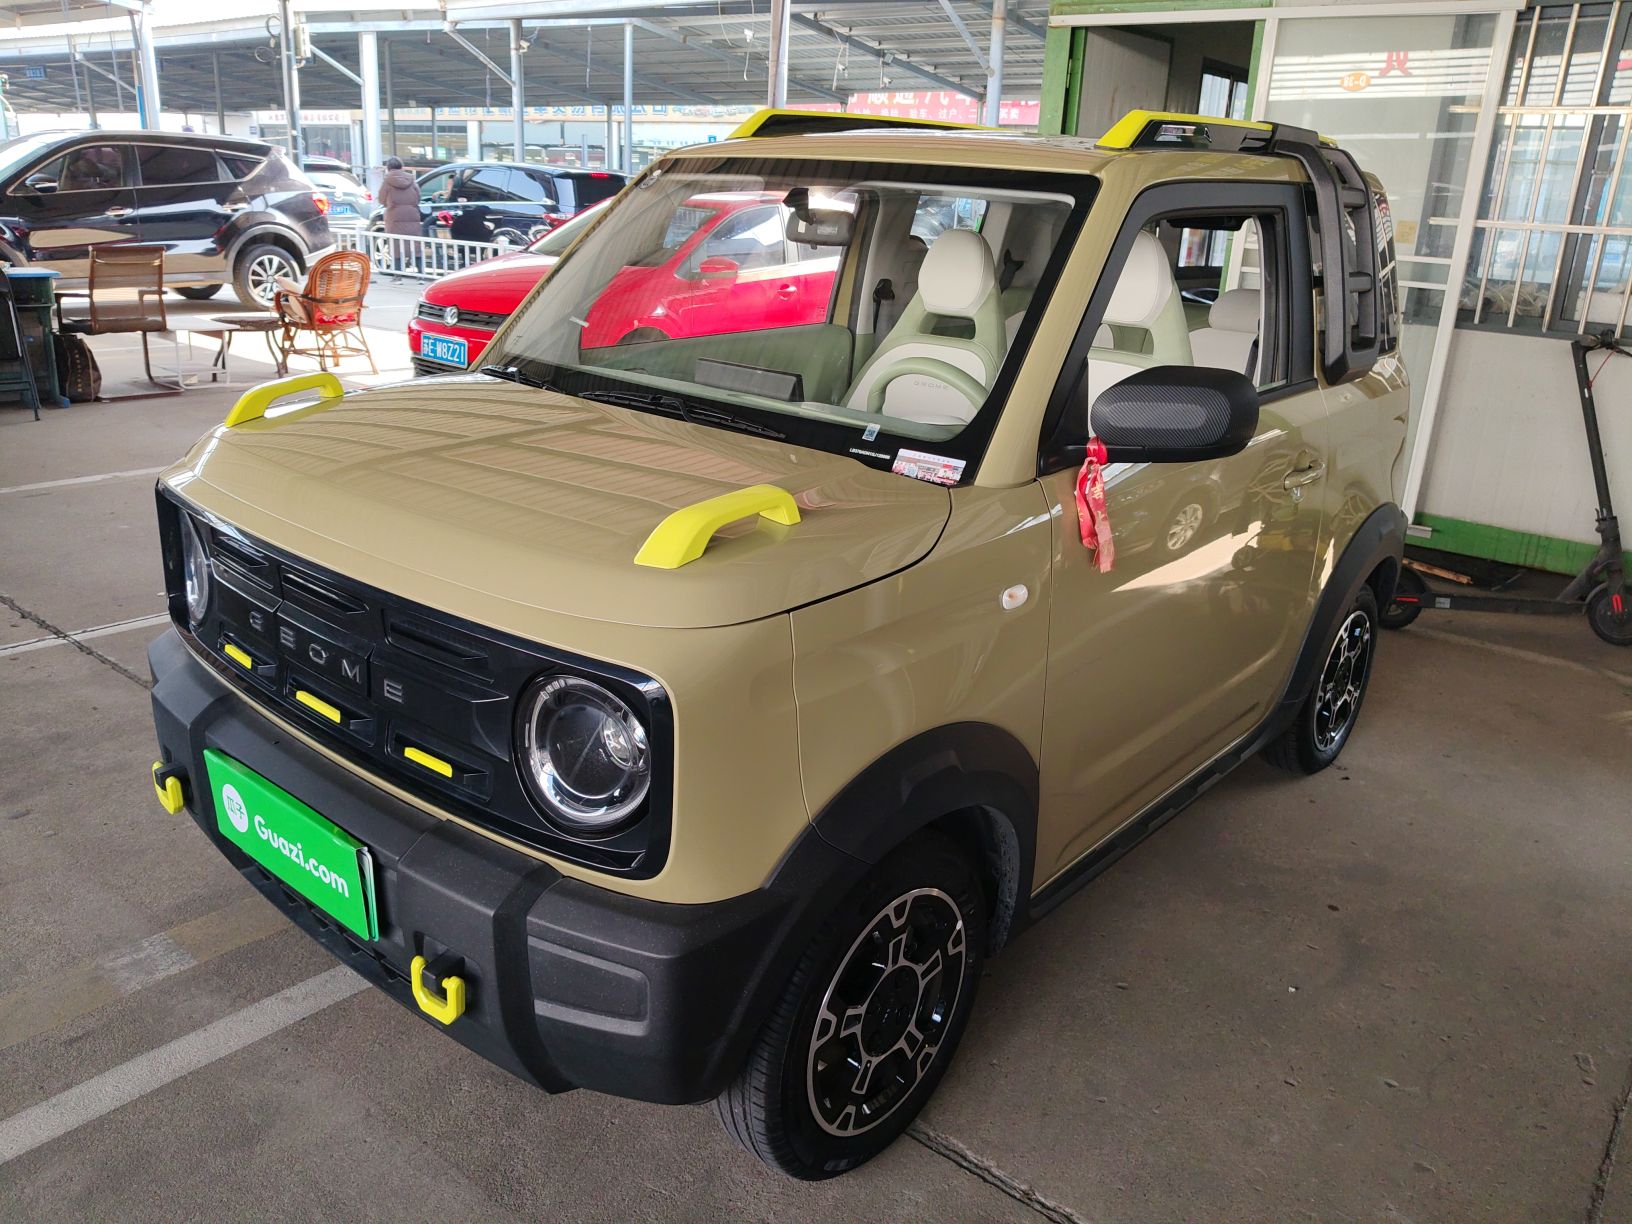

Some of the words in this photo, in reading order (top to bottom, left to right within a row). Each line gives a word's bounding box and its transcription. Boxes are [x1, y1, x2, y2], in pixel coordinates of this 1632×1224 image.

[248, 610, 404, 705] GEOME
[226, 795, 245, 819] 瓜子
[253, 814, 350, 898] Guazi.com
